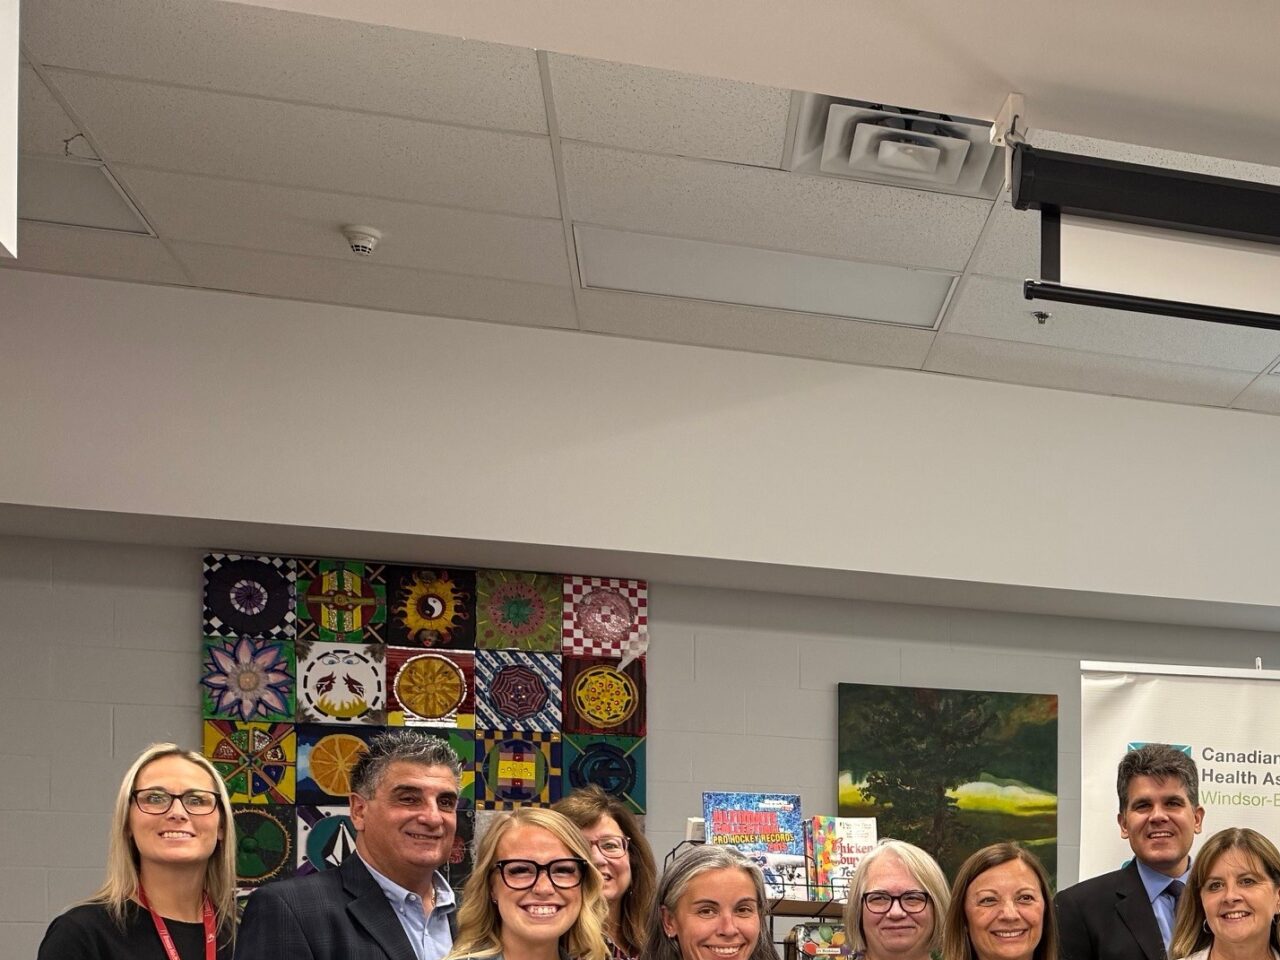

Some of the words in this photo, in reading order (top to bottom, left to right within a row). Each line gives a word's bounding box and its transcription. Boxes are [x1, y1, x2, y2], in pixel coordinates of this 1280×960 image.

[1201, 768, 1258, 785] Health
[713, 834, 728, 844] PRO
[728, 833, 758, 844] HOCKEY
